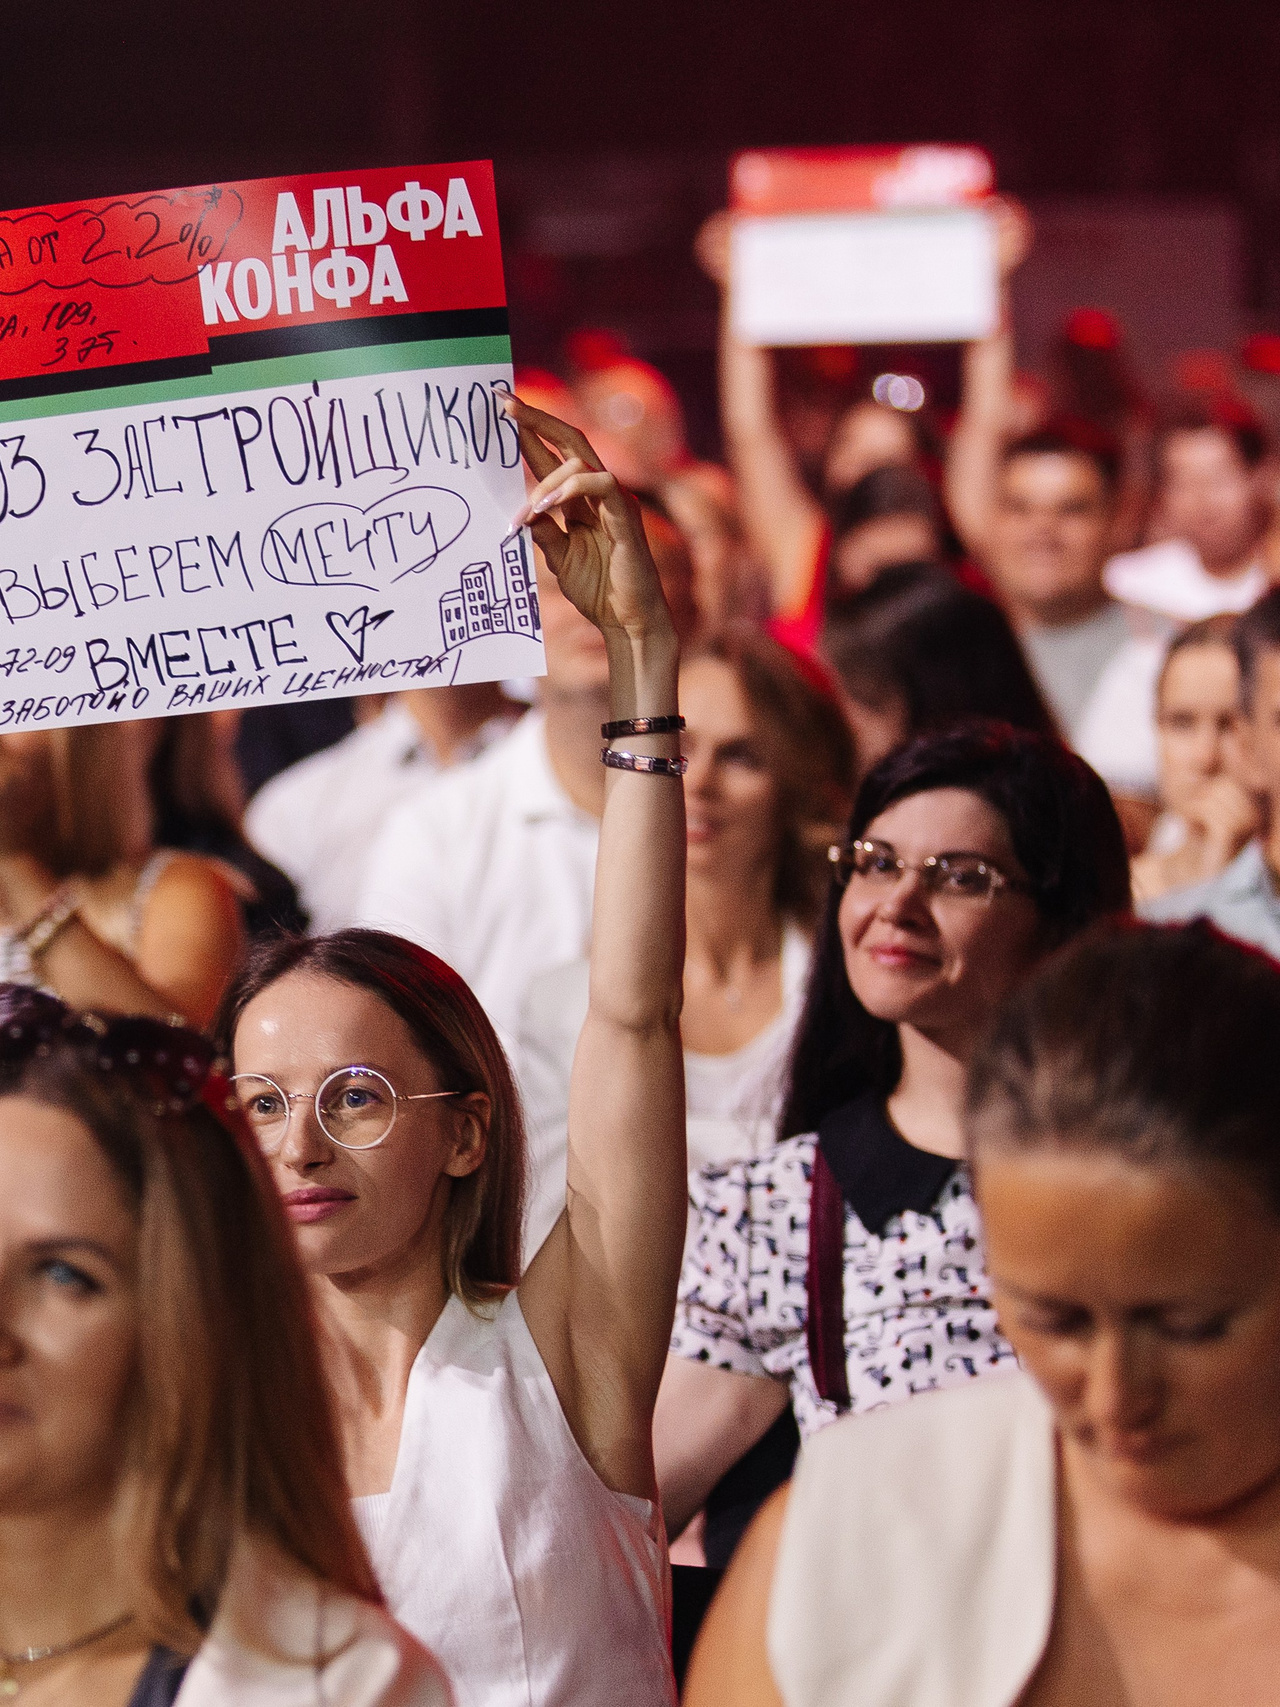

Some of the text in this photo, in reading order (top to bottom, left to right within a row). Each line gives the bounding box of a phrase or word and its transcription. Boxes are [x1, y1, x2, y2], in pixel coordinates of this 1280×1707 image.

[28, 231, 60, 264] ОТ
[271, 177, 483, 254] АЛЬФА
[197, 244, 409, 326] КОНФА
[72, 379, 521, 506] ЗАСТРОЙЩИКОВ
[269, 510, 439, 586] МЕЧТУ
[85, 614, 308, 691] ВМЕСТЕ
[167, 674, 272, 710] ВАШИХ
